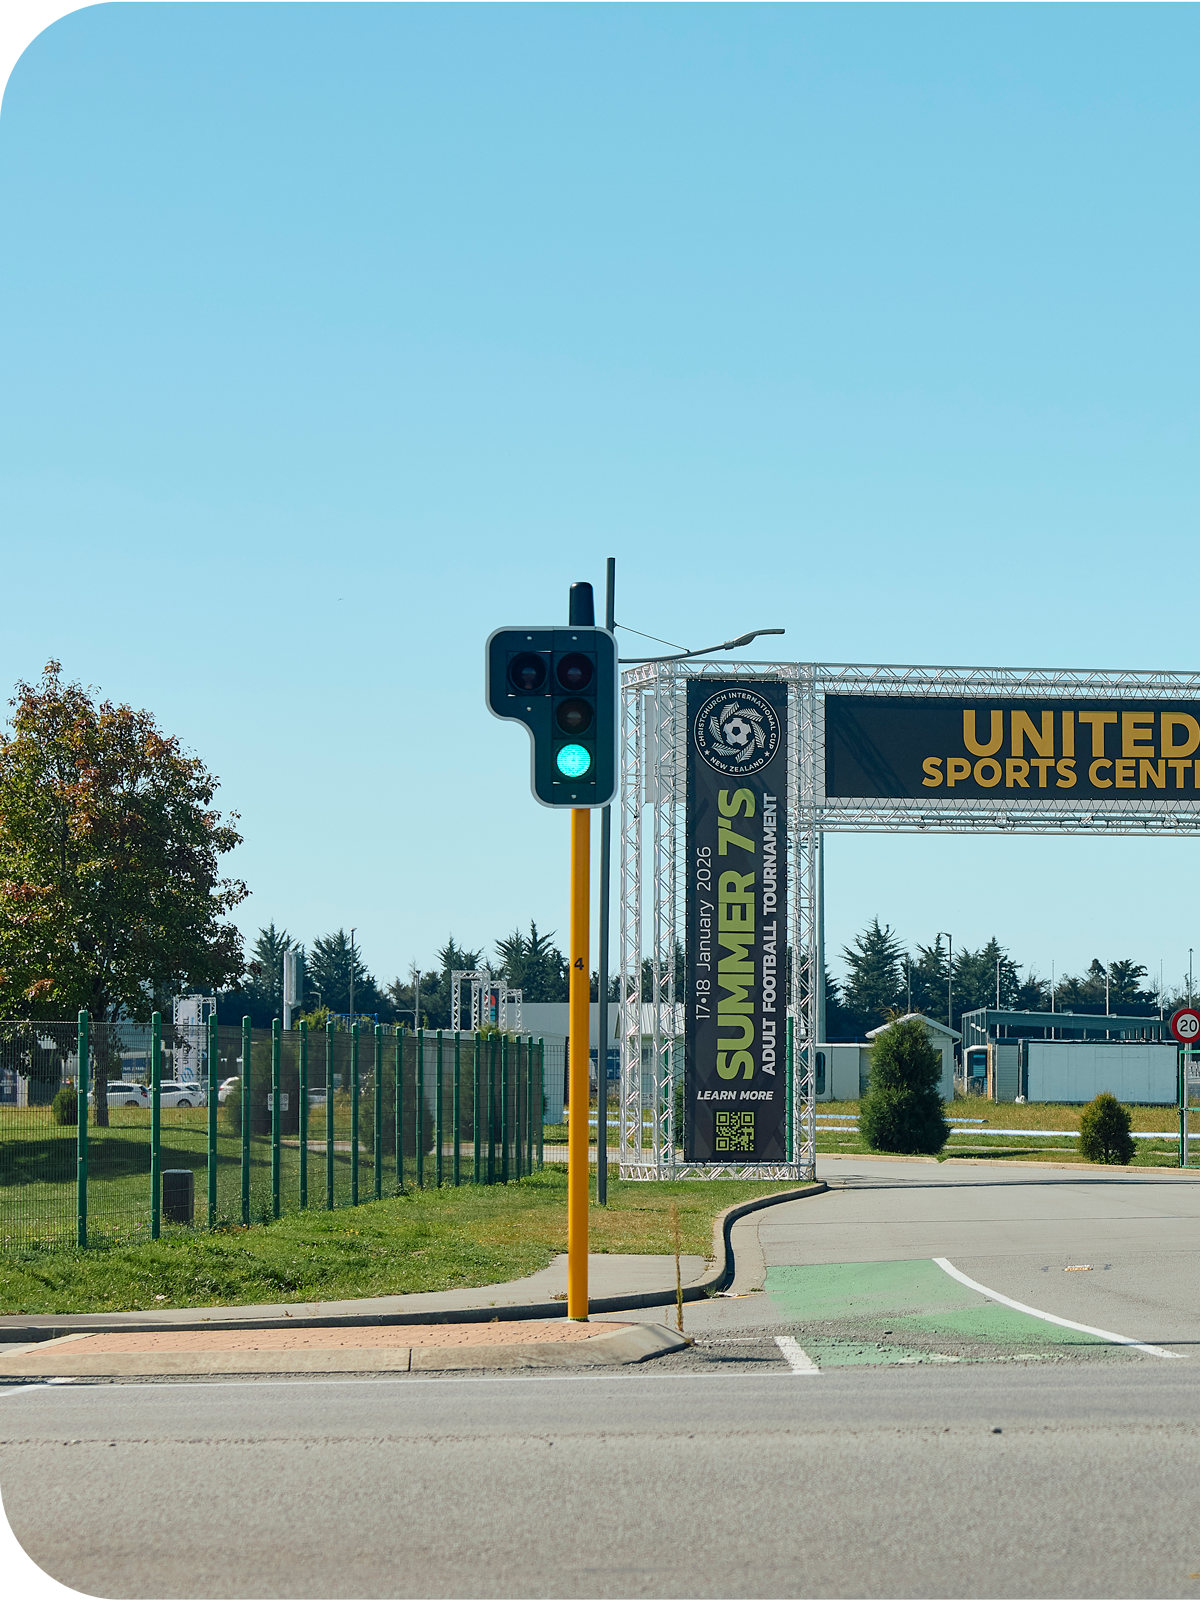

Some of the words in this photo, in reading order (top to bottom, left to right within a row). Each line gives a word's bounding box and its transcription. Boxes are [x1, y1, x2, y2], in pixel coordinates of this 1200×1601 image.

[698, 694, 727, 747] CHRISTCHURCH
[728, 692, 777, 731] INTERNATIONAL
[768, 733, 777, 750] CUP
[962, 709, 1200, 758] UNITED
[710, 756, 728, 770] NEW
[729, 758, 764, 773] ZEALAND
[921, 756, 1078, 789] SPORTS
[696, 846, 711, 891] 2026
[763, 792, 777, 916] TOURNAMENT
[696, 899, 714, 972] January
[574, 957, 585, 971] 4
[716, 870, 755, 1080] SUMMER
[762, 920, 777, 1013] FOOTBALL
[761, 1018, 776, 1076] ADULT
[1180, 1020, 1198, 1033] 20
[696, 1090, 737, 1101] LEARN
[739, 1090, 774, 1101] MORE
